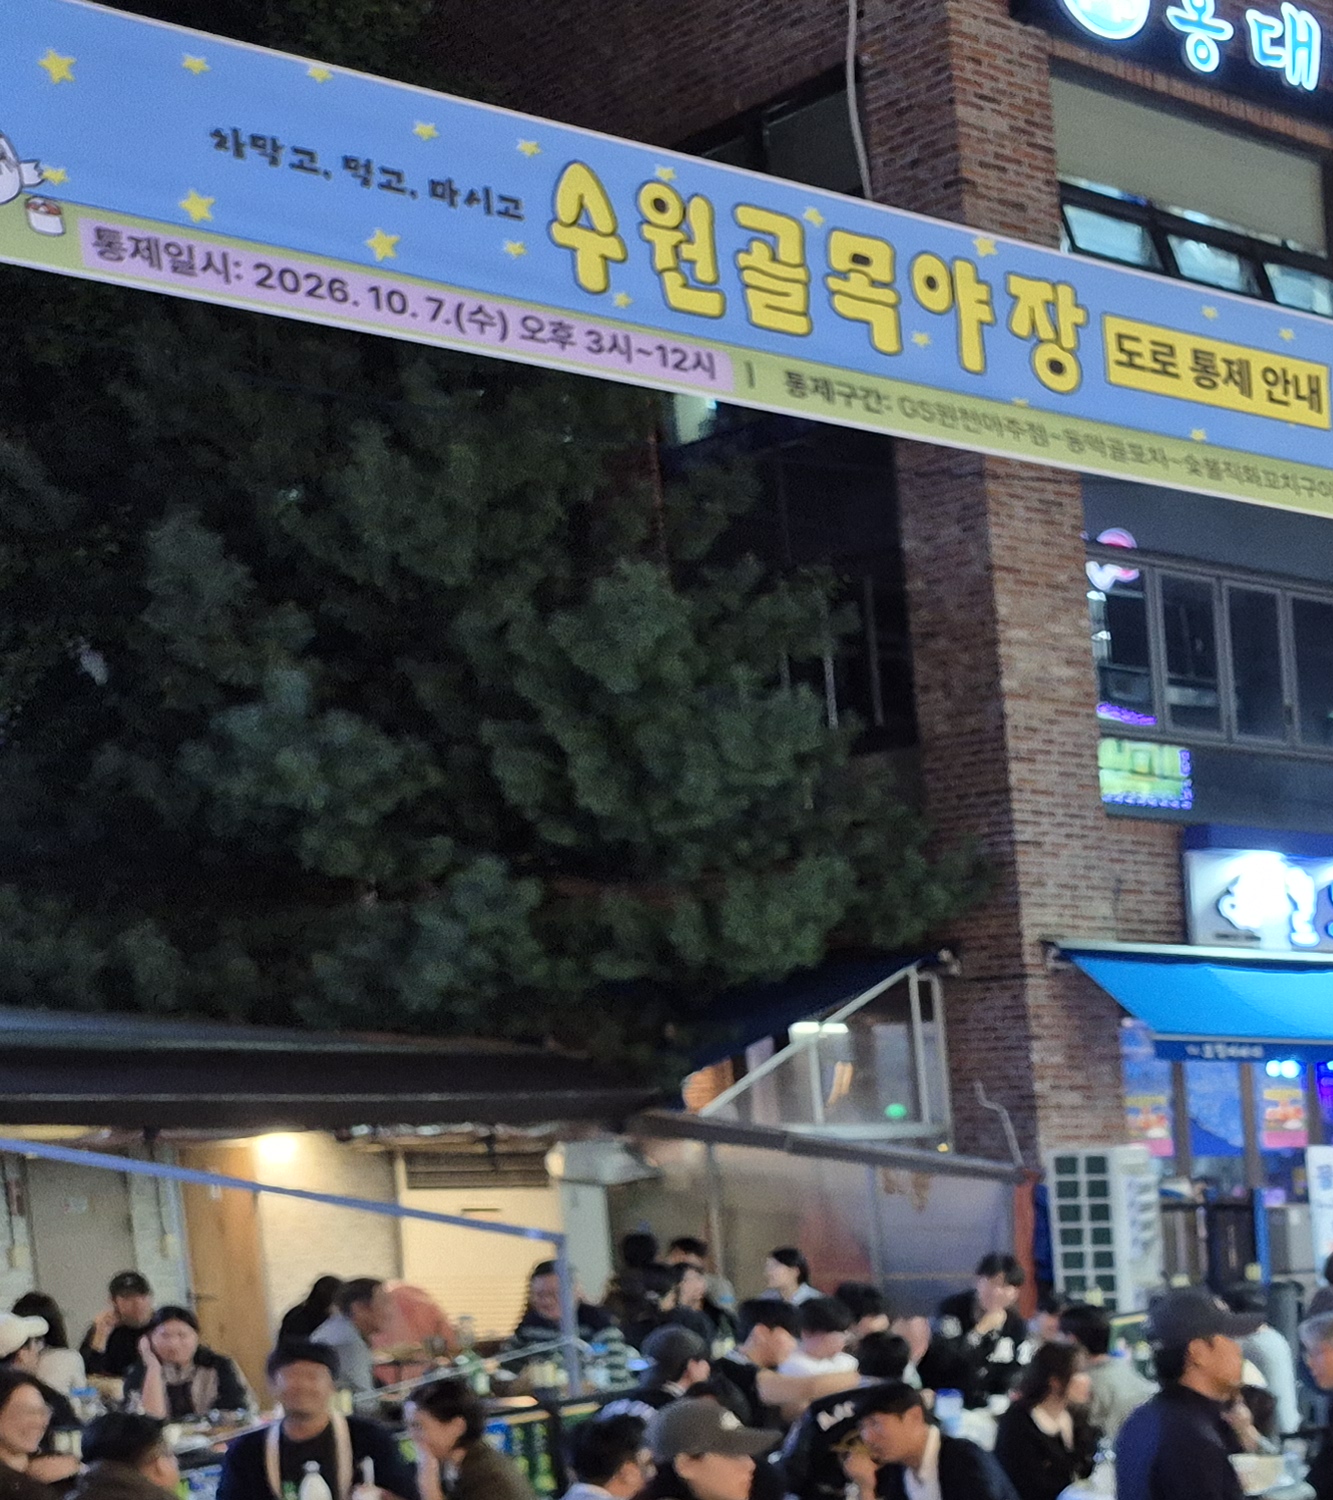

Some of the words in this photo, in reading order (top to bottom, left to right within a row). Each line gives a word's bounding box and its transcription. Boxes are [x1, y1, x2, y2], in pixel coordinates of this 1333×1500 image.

[94, 226, 243, 284] 통제일시:
[521, 310, 576, 350] 오후
[586, 327, 717, 380] 3시~12시
[1114, 329, 1177, 384] 도로
[1189, 347, 1253, 398] 통제
[1262, 365, 1322, 412] 안내
